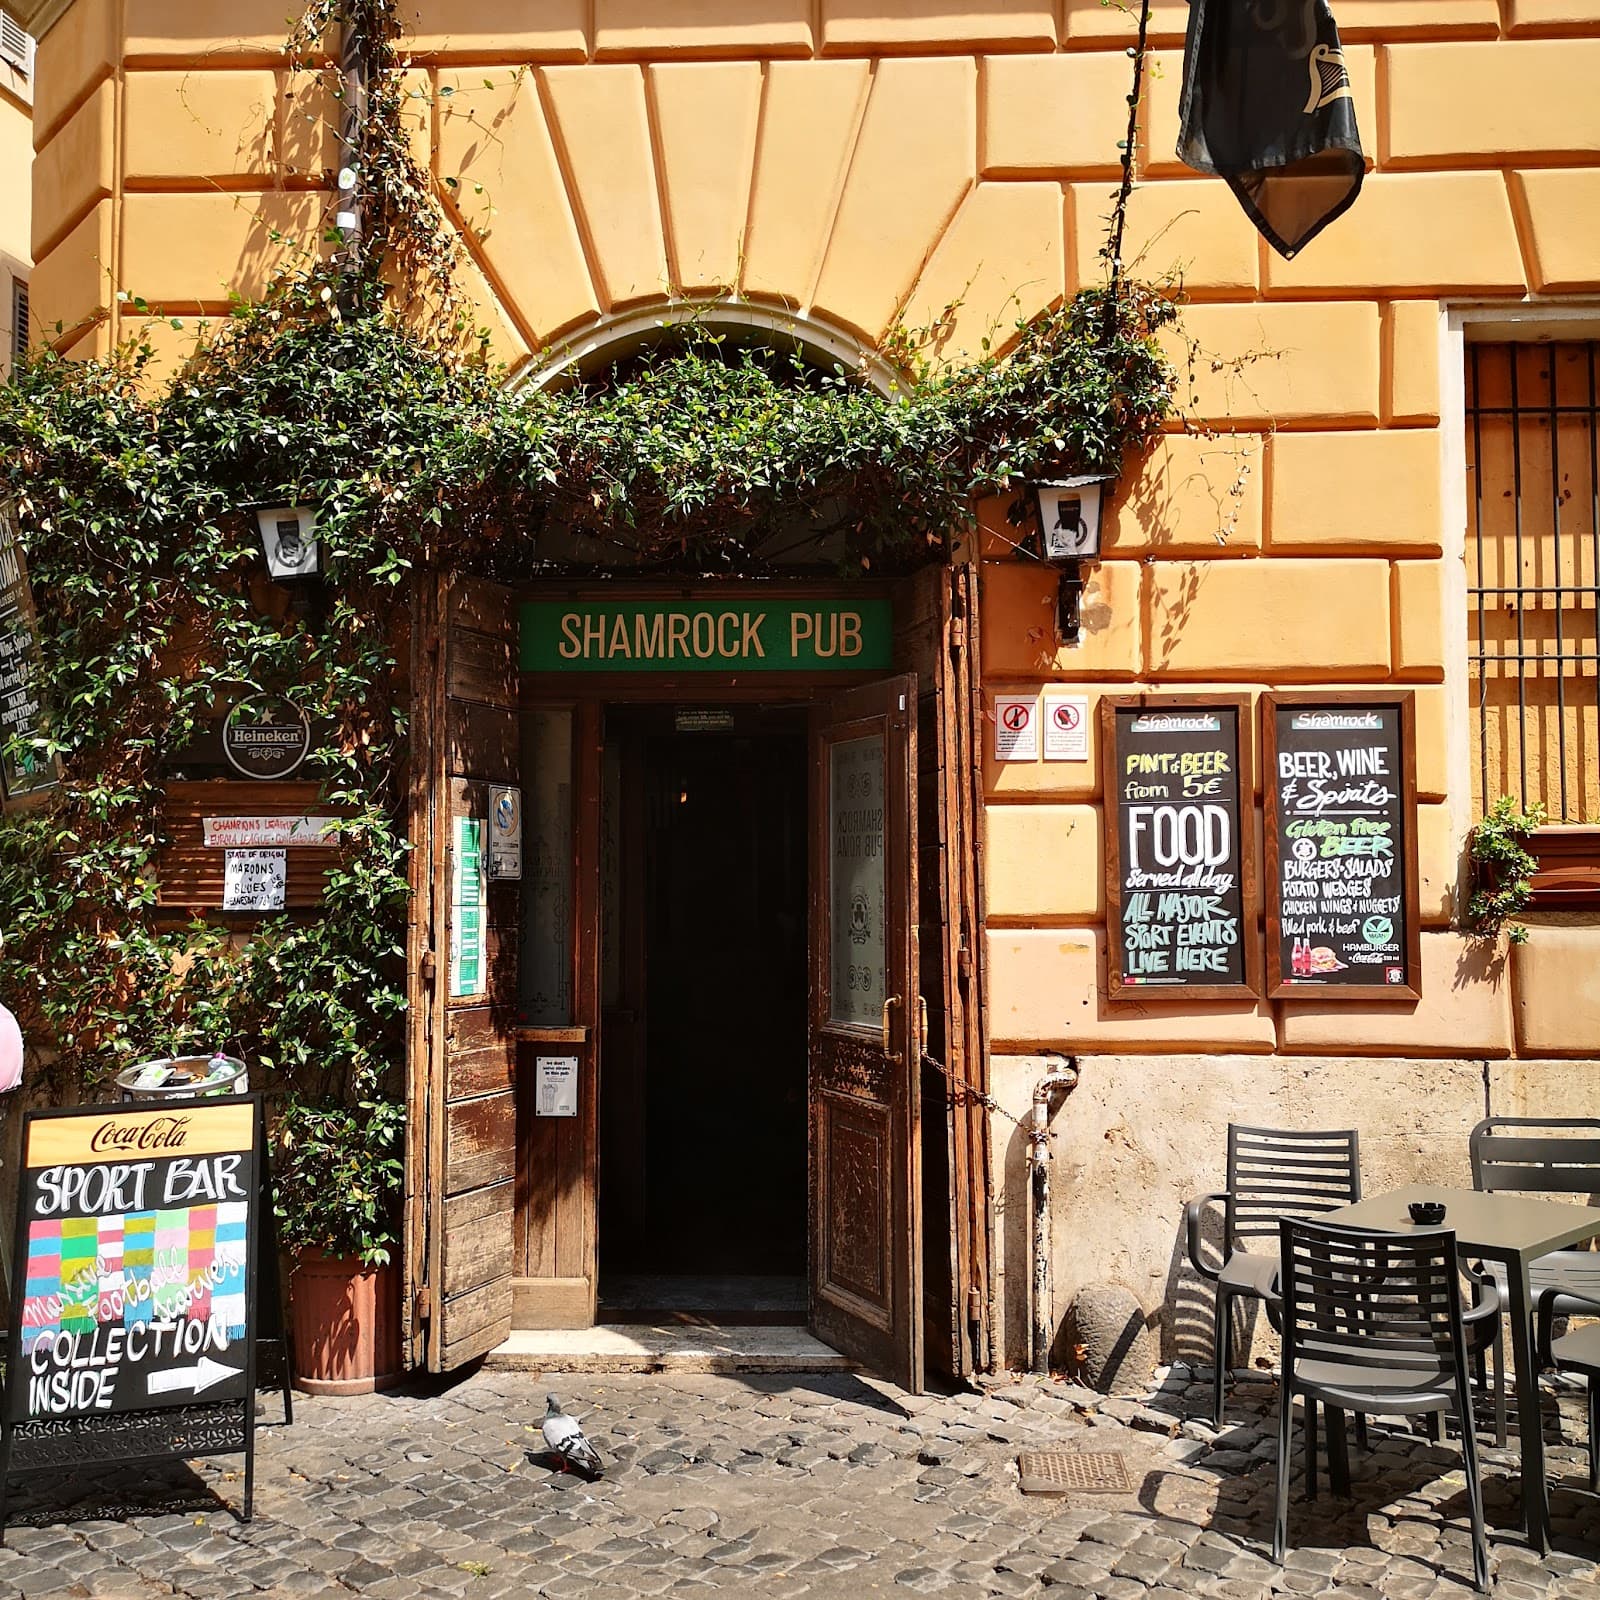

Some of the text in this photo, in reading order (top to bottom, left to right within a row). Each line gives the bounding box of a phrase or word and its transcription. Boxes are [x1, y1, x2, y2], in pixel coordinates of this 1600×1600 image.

[559, 612, 863, 658] SHAMROCK PUB
[1136, 714, 1216, 729] Shamrock
[1296, 712, 1378, 727] Shamrock
[234, 730, 299, 742] Heineken
[1126, 753, 1177, 775] PINT
[1180, 750, 1231, 776] BEER
[1279, 747, 1390, 780] BEER, WINE
[1124, 775, 1224, 799] from 5€
[1129, 804, 1231, 869] FOOD
[1285, 820, 1347, 838] Gluten
[1320, 836, 1394, 858] BEER
[231, 863, 274, 876] MAROONS
[1182, 864, 1204, 888] all
[1200, 865, 1234, 895] day
[1344, 858, 1394, 879] SALADS
[234, 881, 266, 894] BLUES
[1282, 877, 1371, 898] POTATO WEDGES
[1123, 893, 1231, 923] ALL MAJOR
[1283, 900, 1317, 916] CHICKEN
[1321, 898, 1352, 914] WINGS
[1359, 895, 1400, 914] NUGGETS
[1125, 918, 1238, 950] SPORT EVENTS
[1128, 947, 1230, 974] LIVE HERE
[1342, 943, 1399, 952] HAMBURGER
[91, 1117, 191, 1153] Coca-Cola
[35, 1154, 247, 1214] SPORT BAR
[82, 1246, 184, 1326] Football
[31, 1318, 230, 1375] COLLECTION
[28, 1367, 118, 1416] INSIDE
